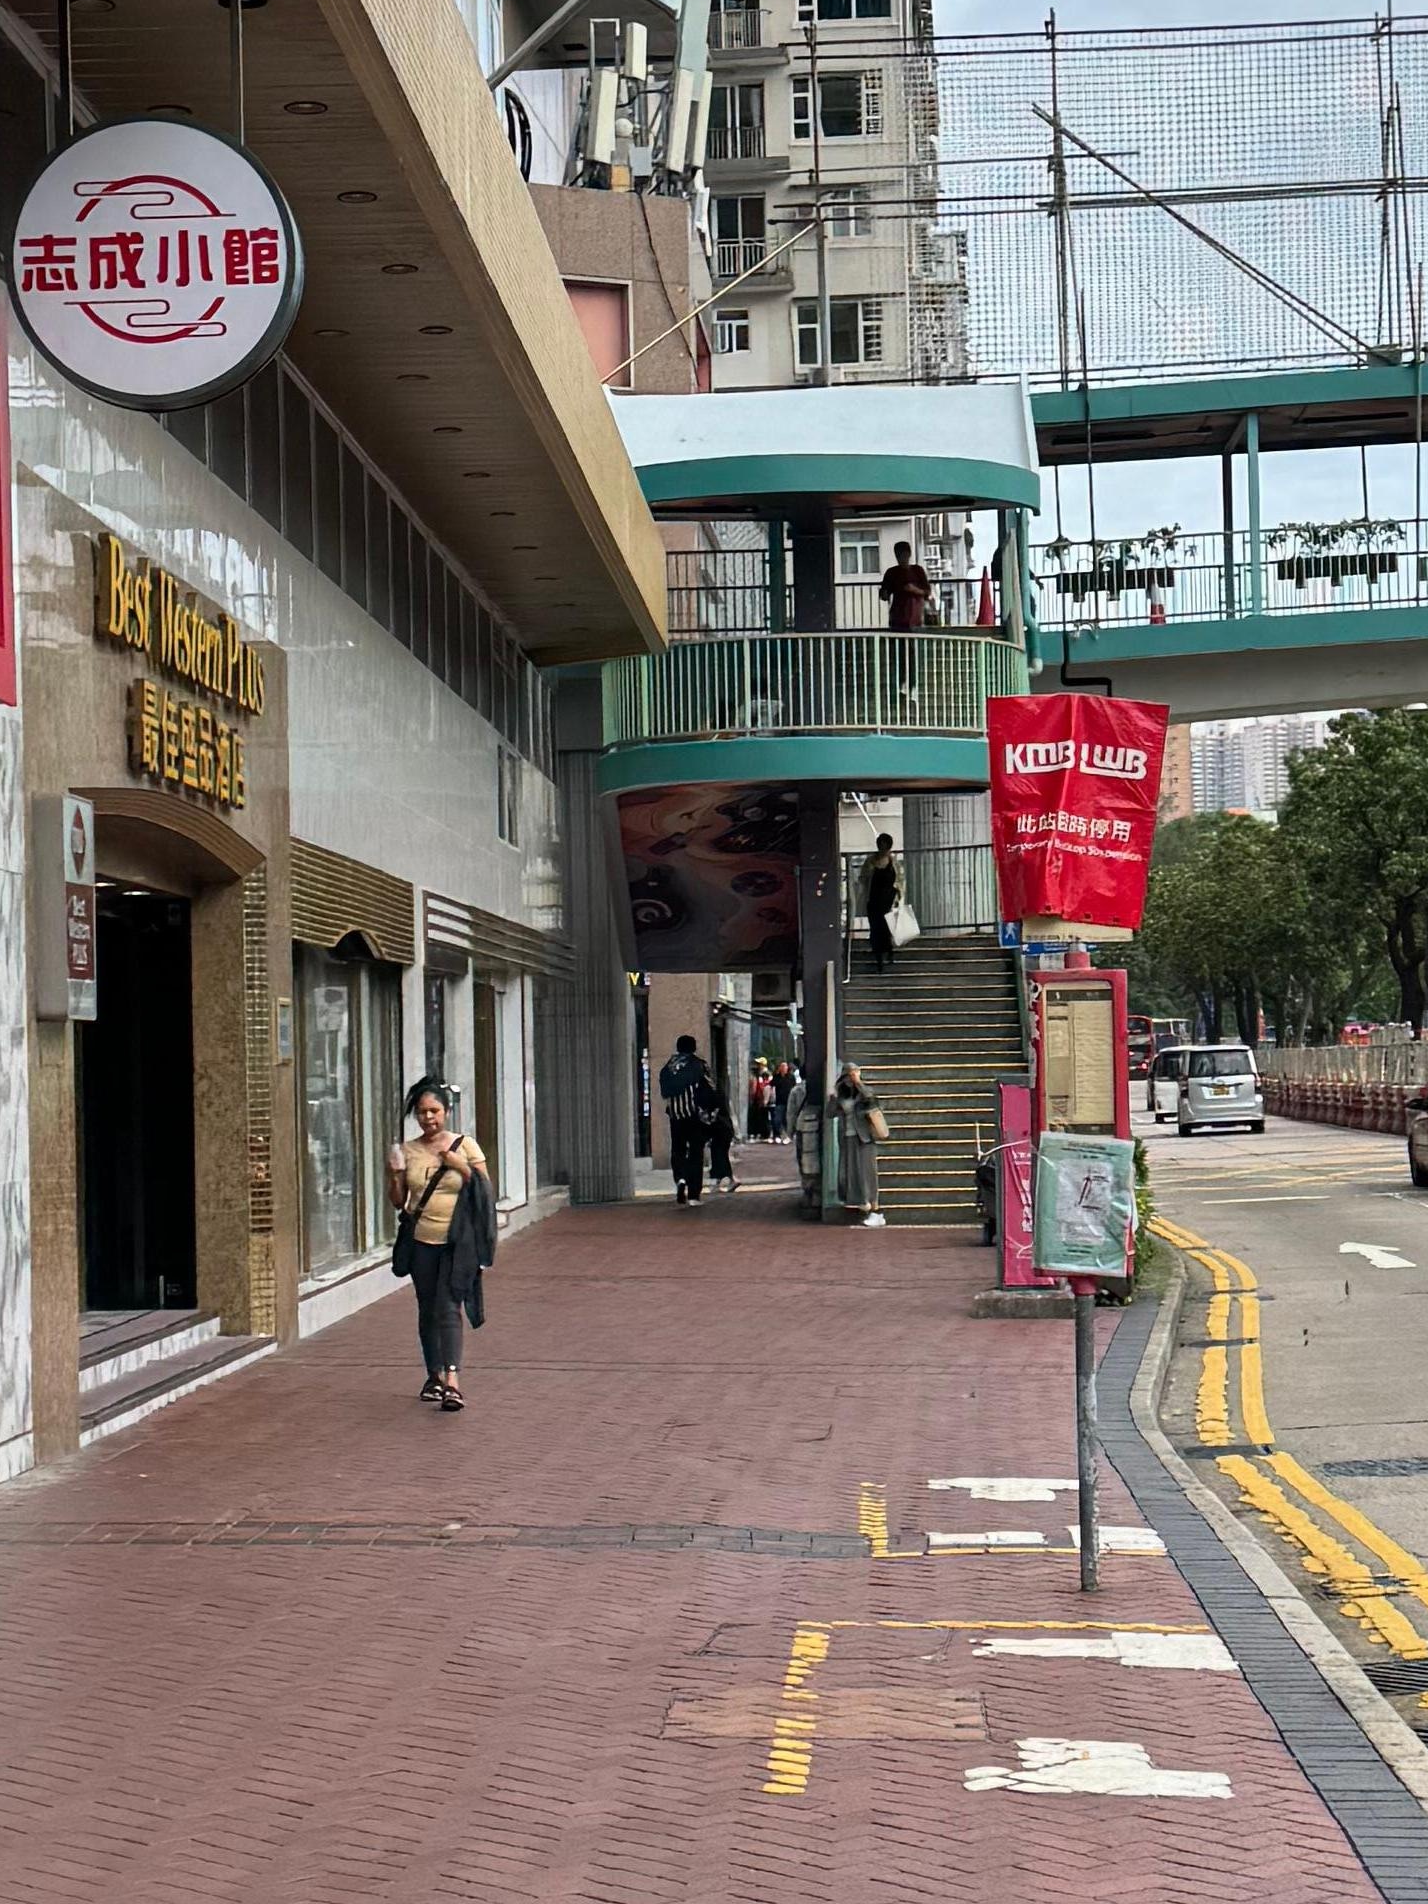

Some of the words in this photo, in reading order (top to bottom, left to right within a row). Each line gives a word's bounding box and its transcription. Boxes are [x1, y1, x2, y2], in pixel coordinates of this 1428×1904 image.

[20, 228, 280, 293] 志成小館
[109, 534, 152, 652] Best
[160, 569, 224, 694] Western
